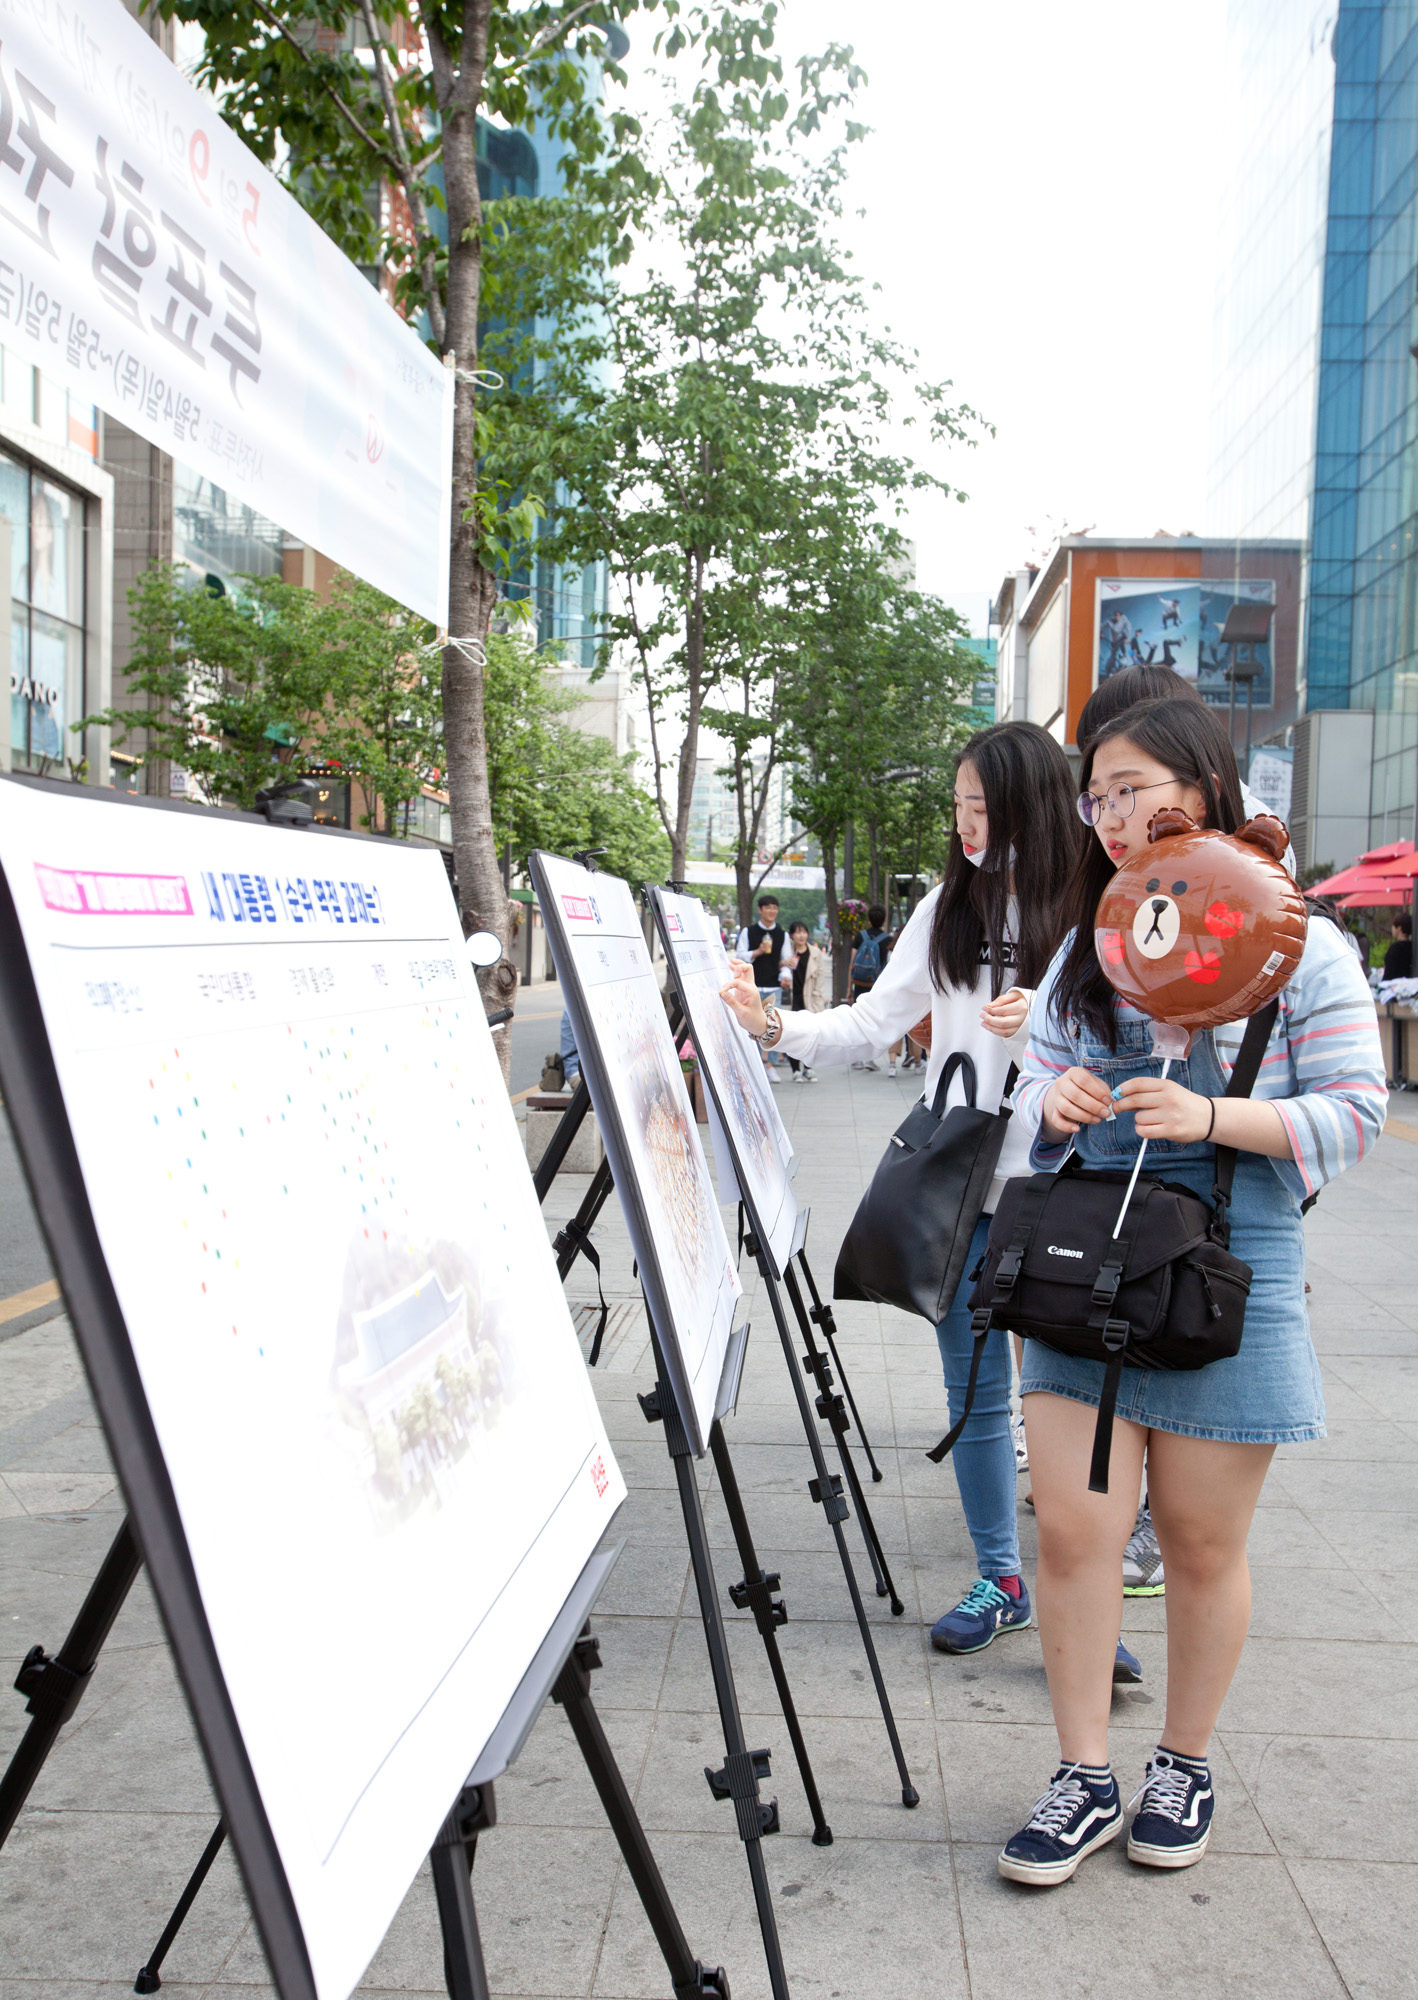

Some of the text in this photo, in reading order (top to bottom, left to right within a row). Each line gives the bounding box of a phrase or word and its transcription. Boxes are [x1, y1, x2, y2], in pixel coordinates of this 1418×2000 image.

[201, 871, 225, 922] 새
[221, 872, 277, 923] 대통령
[275, 876, 317, 923] 1순위
[313, 879, 344, 923] 역점
[340, 881, 386, 925] 과제는?
[1047, 1245, 1084, 1259] Canon
